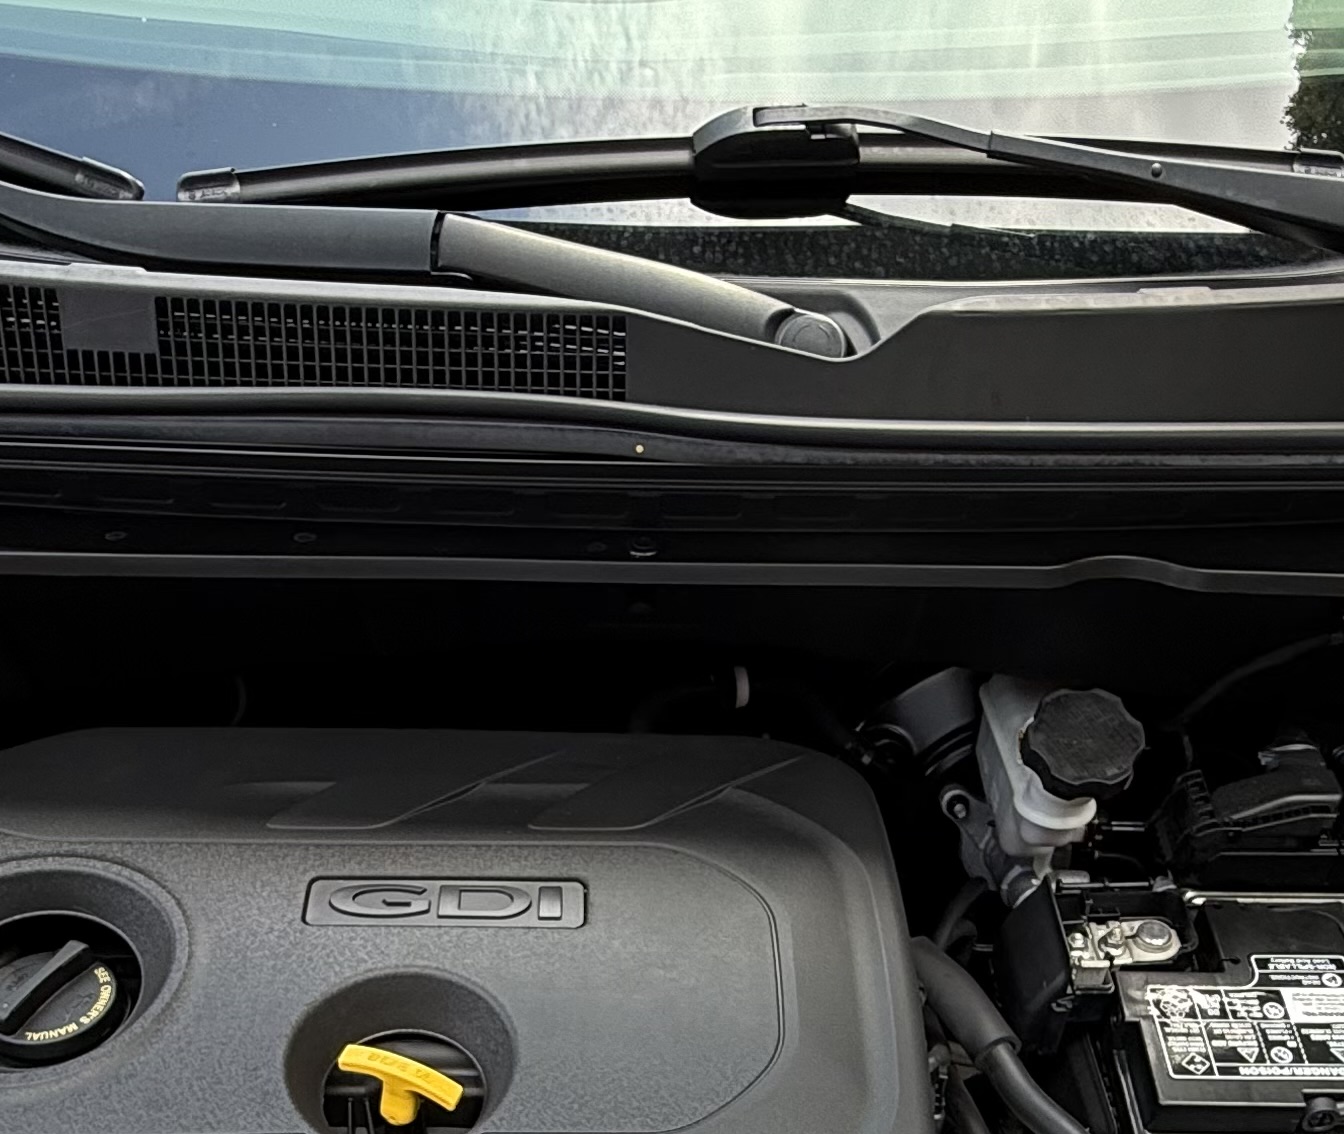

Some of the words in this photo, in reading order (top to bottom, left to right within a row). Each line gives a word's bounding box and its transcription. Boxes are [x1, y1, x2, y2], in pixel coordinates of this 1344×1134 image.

[328, 884, 563, 921] GDI
[94, 967, 111, 983] SEE
[25, 1022, 79, 1041] MANUAL
